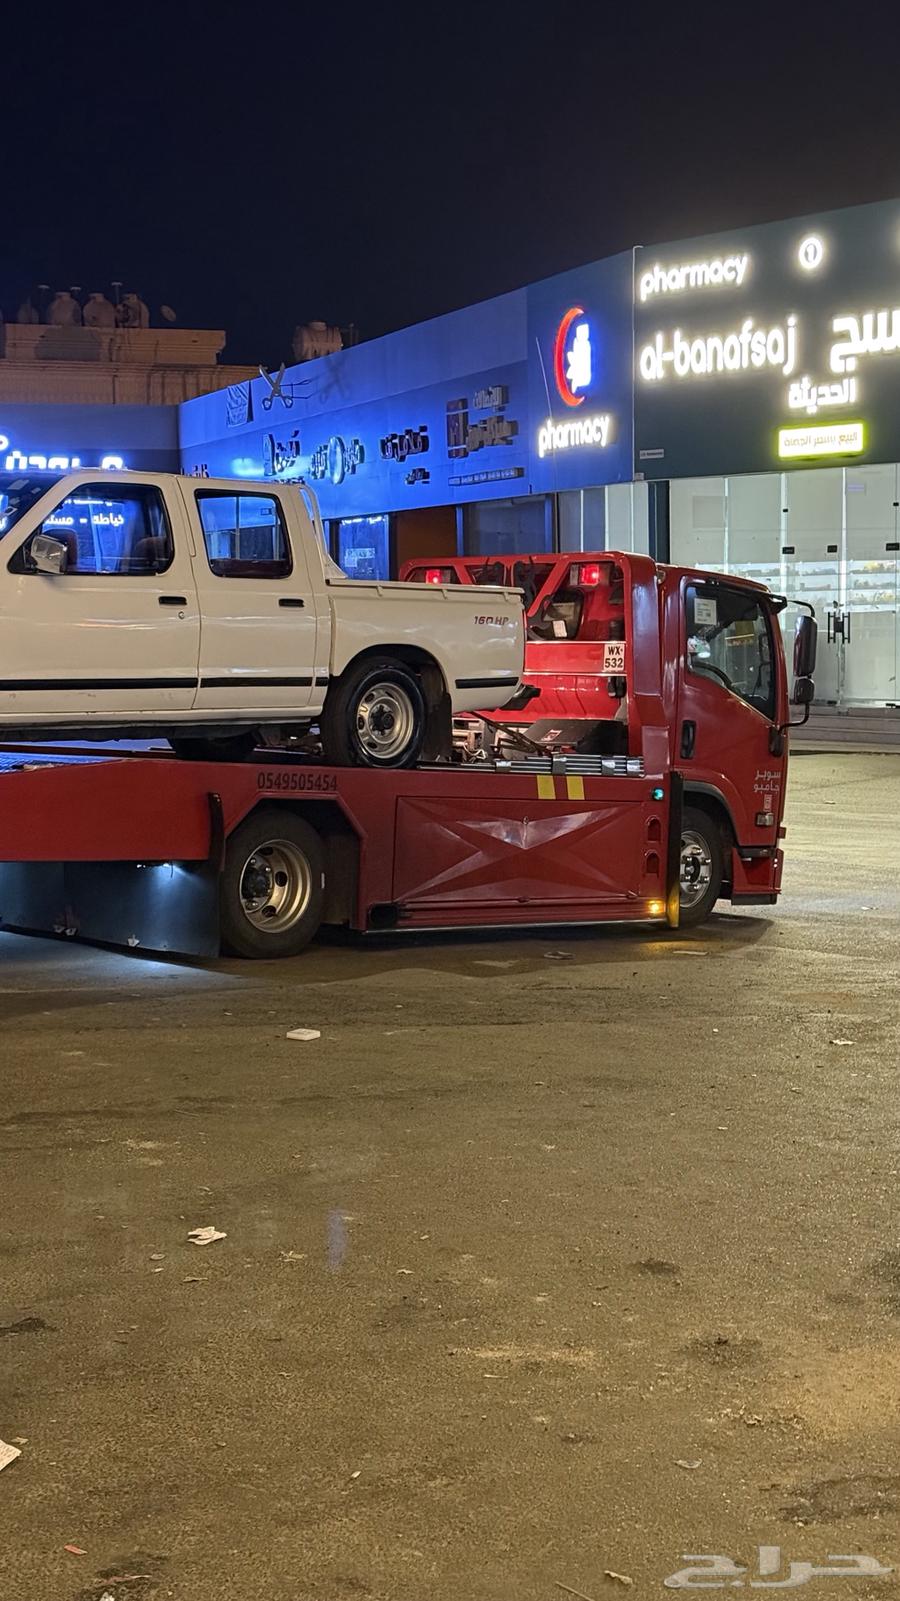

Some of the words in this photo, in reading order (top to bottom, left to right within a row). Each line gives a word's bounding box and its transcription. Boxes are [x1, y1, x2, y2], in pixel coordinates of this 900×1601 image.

[640, 255, 748, 302] pharmacy
[640, 314, 797, 381] al-banafsaj
[789, 376, 856, 414] الحديثة
[538, 413, 610, 459] pharmacy
[474, 616, 494, 625] 160
[495, 616, 509, 626] HP
[604, 658, 624, 668] 532
[257, 772, 337, 791] 0549505454
[753, 780, 780, 795] جامبو
